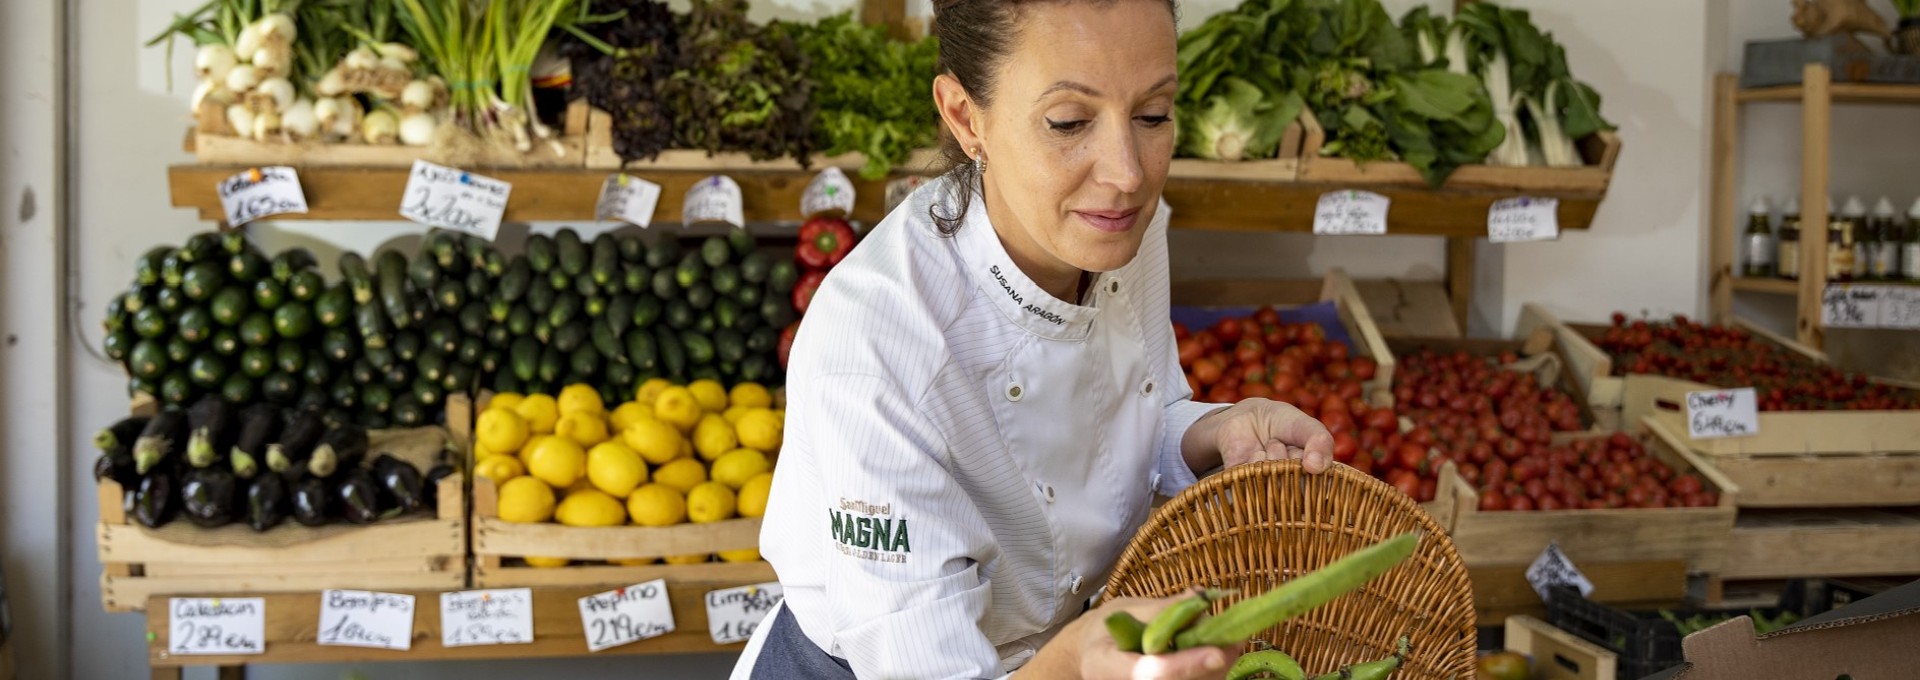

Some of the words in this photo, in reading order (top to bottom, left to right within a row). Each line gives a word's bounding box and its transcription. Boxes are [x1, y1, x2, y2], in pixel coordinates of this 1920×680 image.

[989, 265, 1024, 305] SUSANA
[829, 508, 911, 553] MAGNA
[586, 584, 658, 612] Pepino
